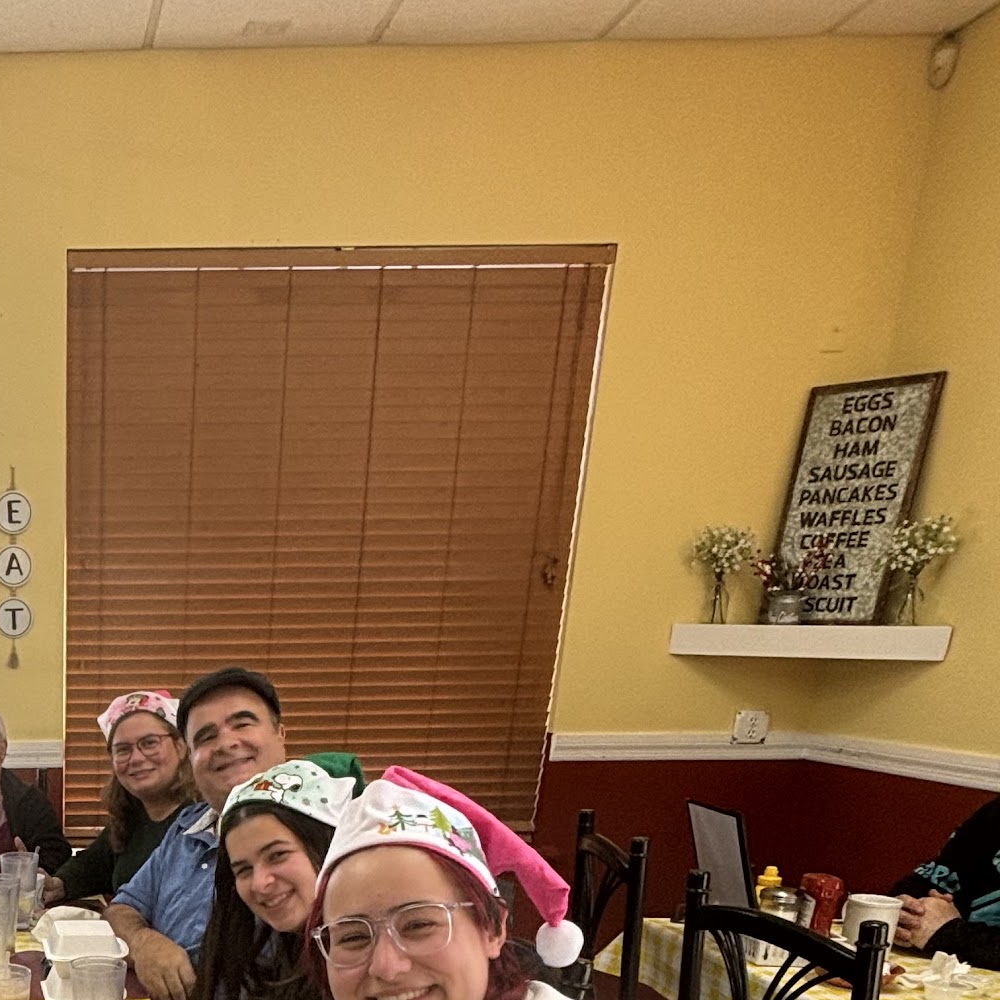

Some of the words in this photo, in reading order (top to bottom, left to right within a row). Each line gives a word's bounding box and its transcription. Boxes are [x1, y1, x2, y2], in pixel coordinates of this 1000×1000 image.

[842, 391, 895, 415] EGGS
[829, 415, 898, 437] BACON
[833, 440, 879, 458] HAM
[808, 460, 898, 484] SAUSAGE
[798, 483, 899, 506] PANCAKES
[800, 507, 887, 529] WAFFLES
[800, 573, 857, 591] OAST
[801, 596, 858, 613] SCUIT
